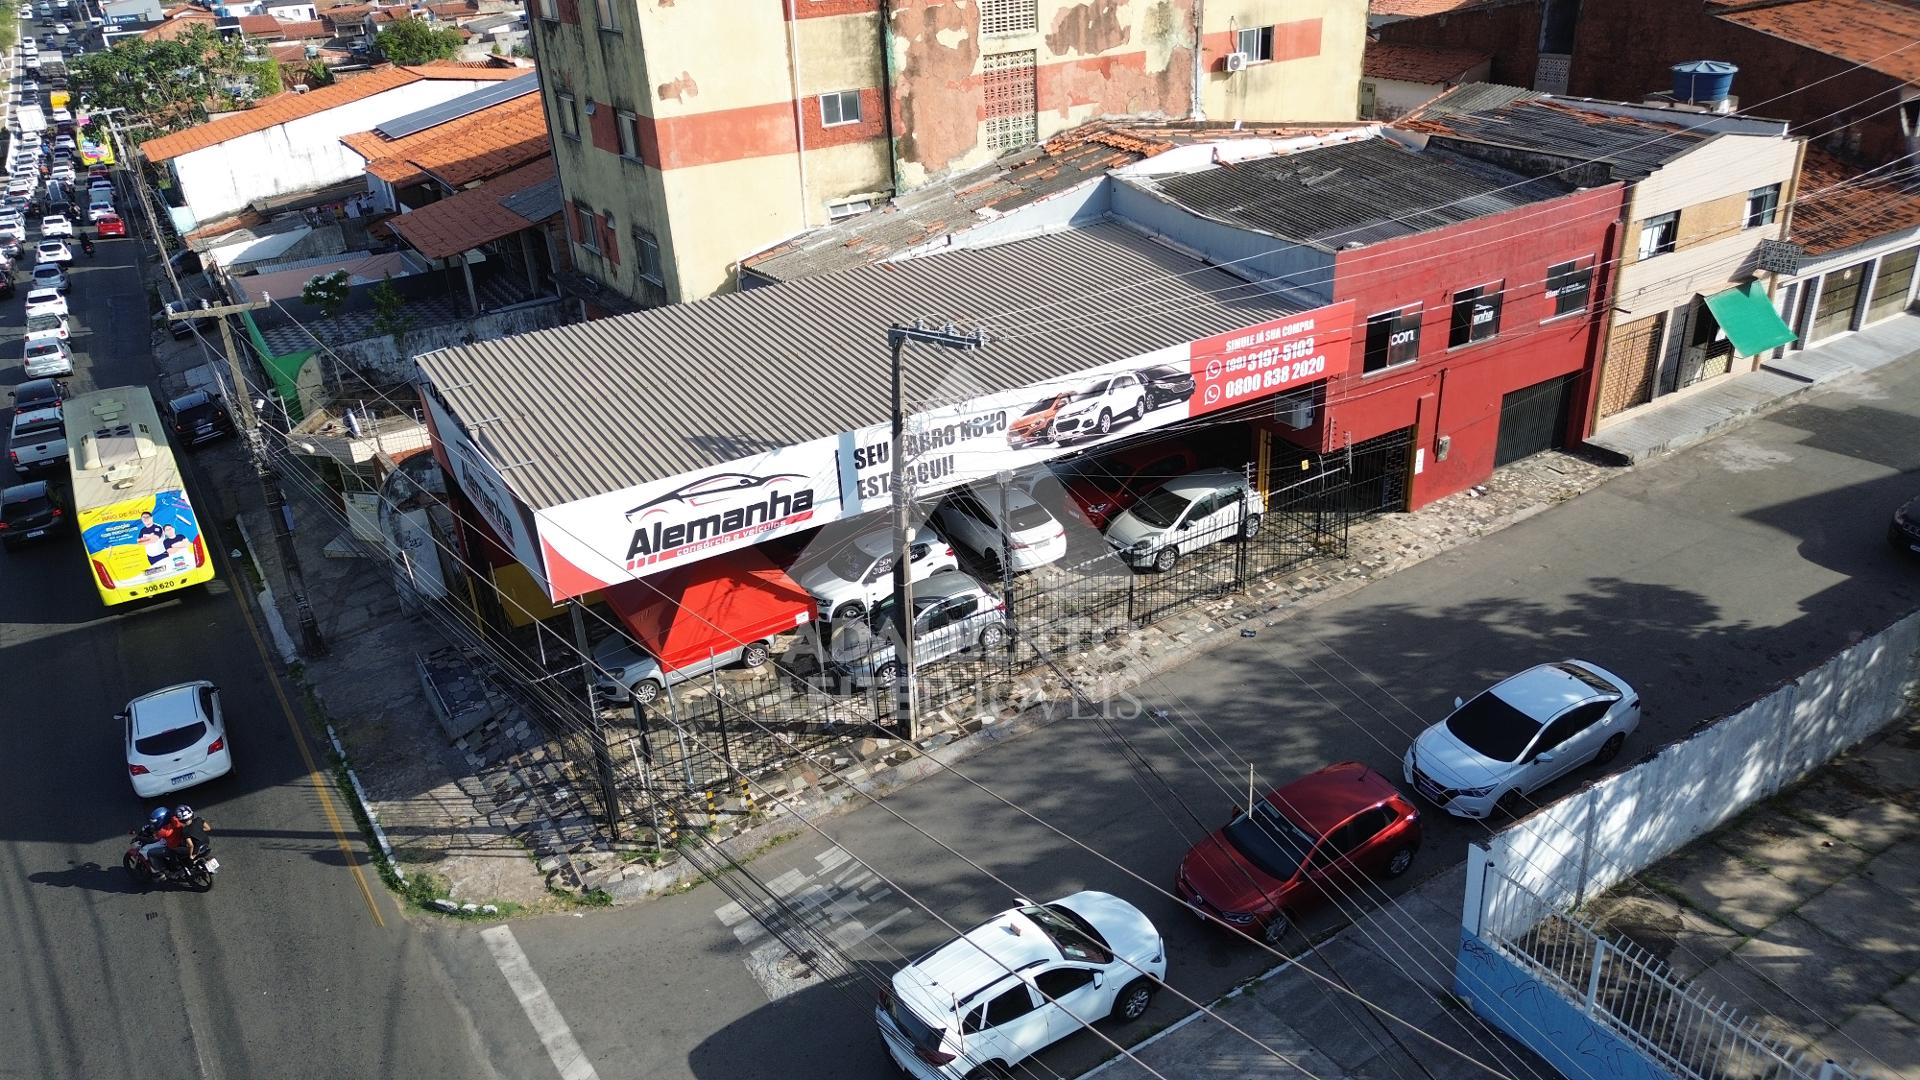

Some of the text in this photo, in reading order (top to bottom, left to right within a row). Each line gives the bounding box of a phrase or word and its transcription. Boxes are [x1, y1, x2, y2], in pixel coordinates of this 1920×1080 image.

[1226, 334, 1255, 351] SIMULE
[1265, 327, 1281, 341] SUA
[1282, 319, 1314, 337] COMPRA
[1225, 355, 1325, 399] 0800 838 2020
[853, 410, 1007, 470] SEU ARRO NOVO
[856, 454, 955, 501] EST AQUI!
[626, 488, 813, 560] Alemanha
